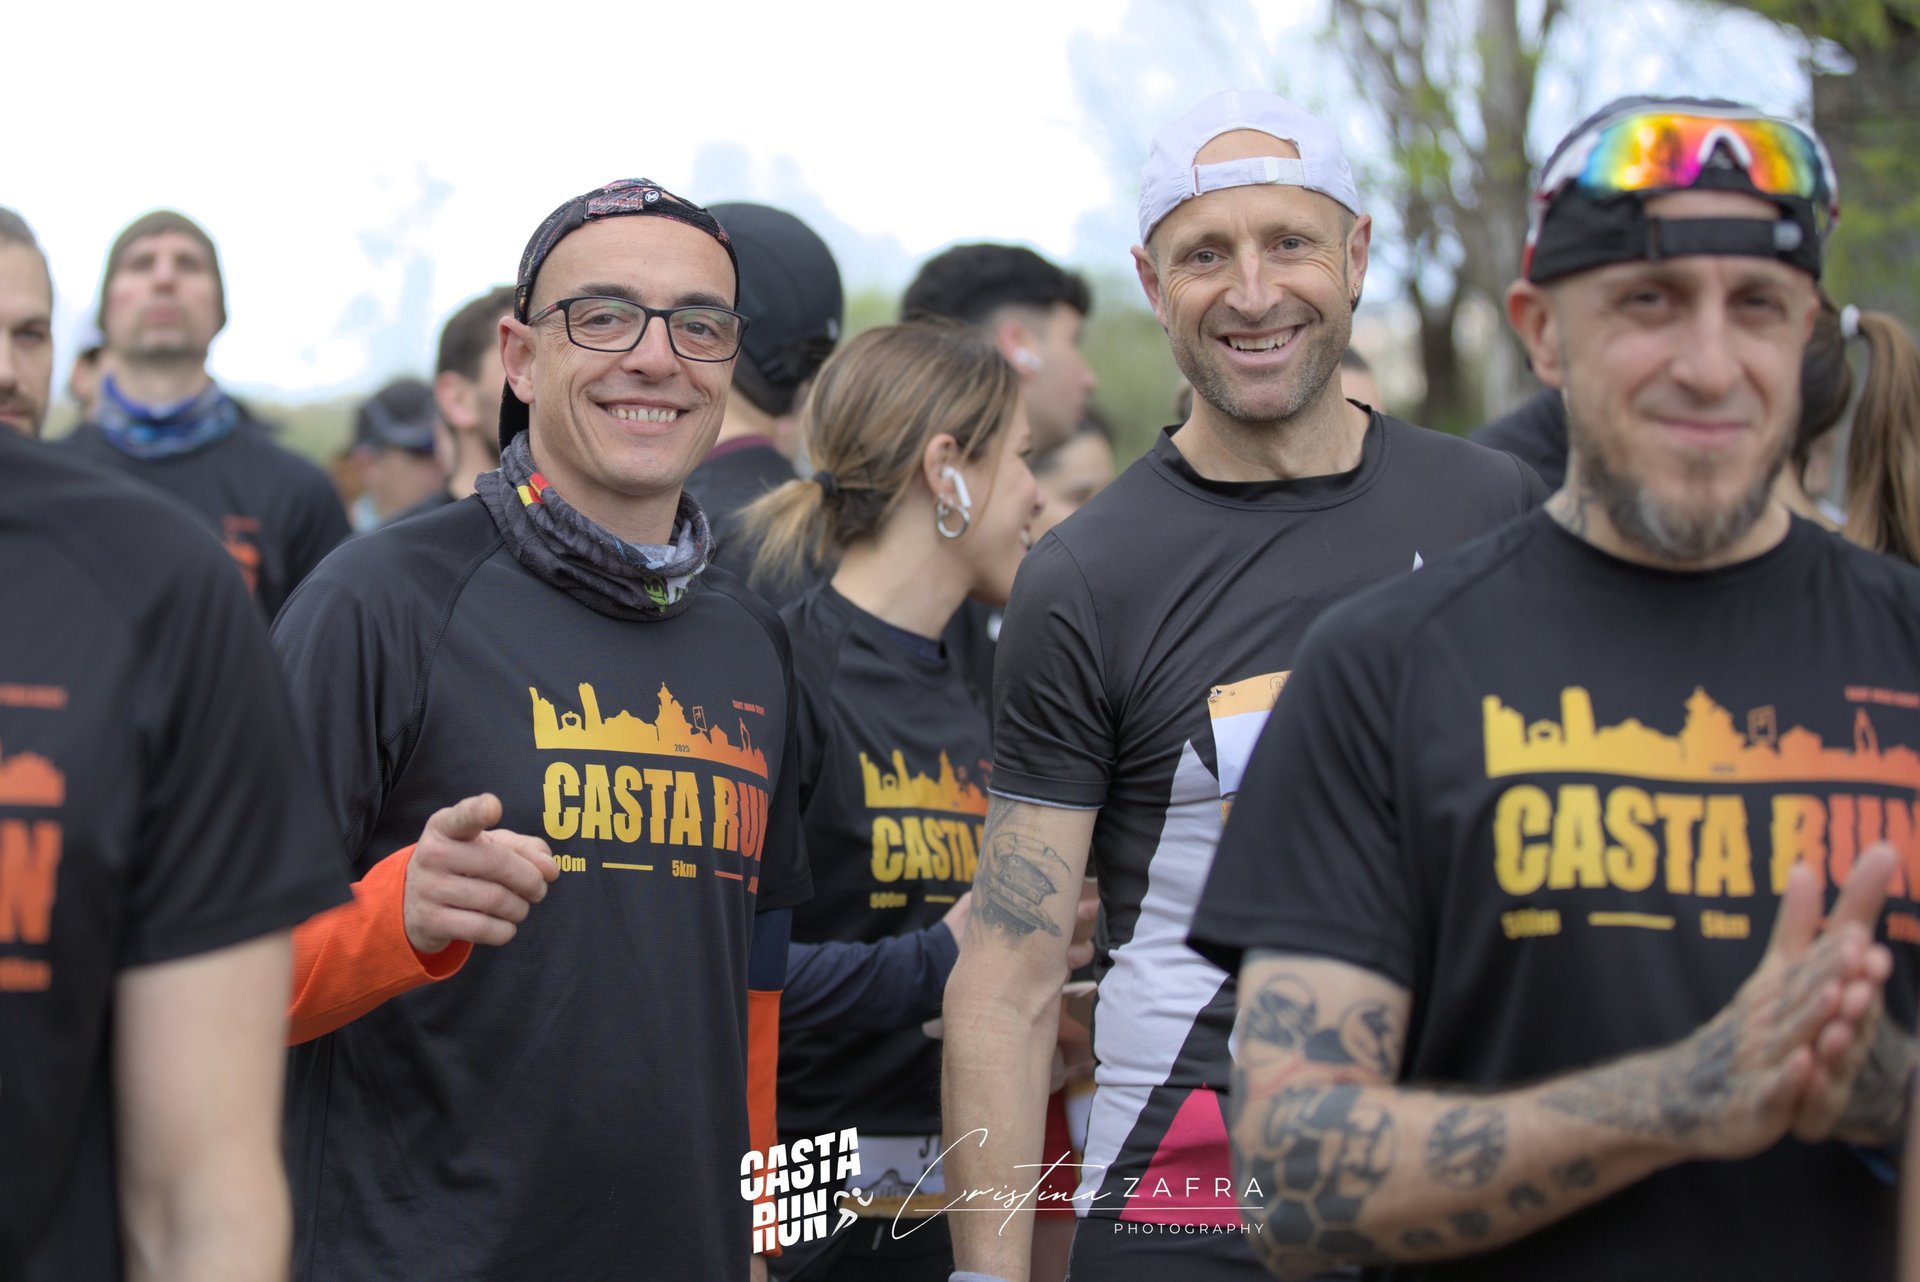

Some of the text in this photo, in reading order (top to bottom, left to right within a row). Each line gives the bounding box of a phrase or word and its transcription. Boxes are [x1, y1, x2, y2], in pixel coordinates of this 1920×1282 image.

[542, 761, 702, 846] CASTA
[1494, 784, 1755, 897] CASTA
[671, 860, 697, 879] 5km
[871, 816, 979, 883] CASTA
